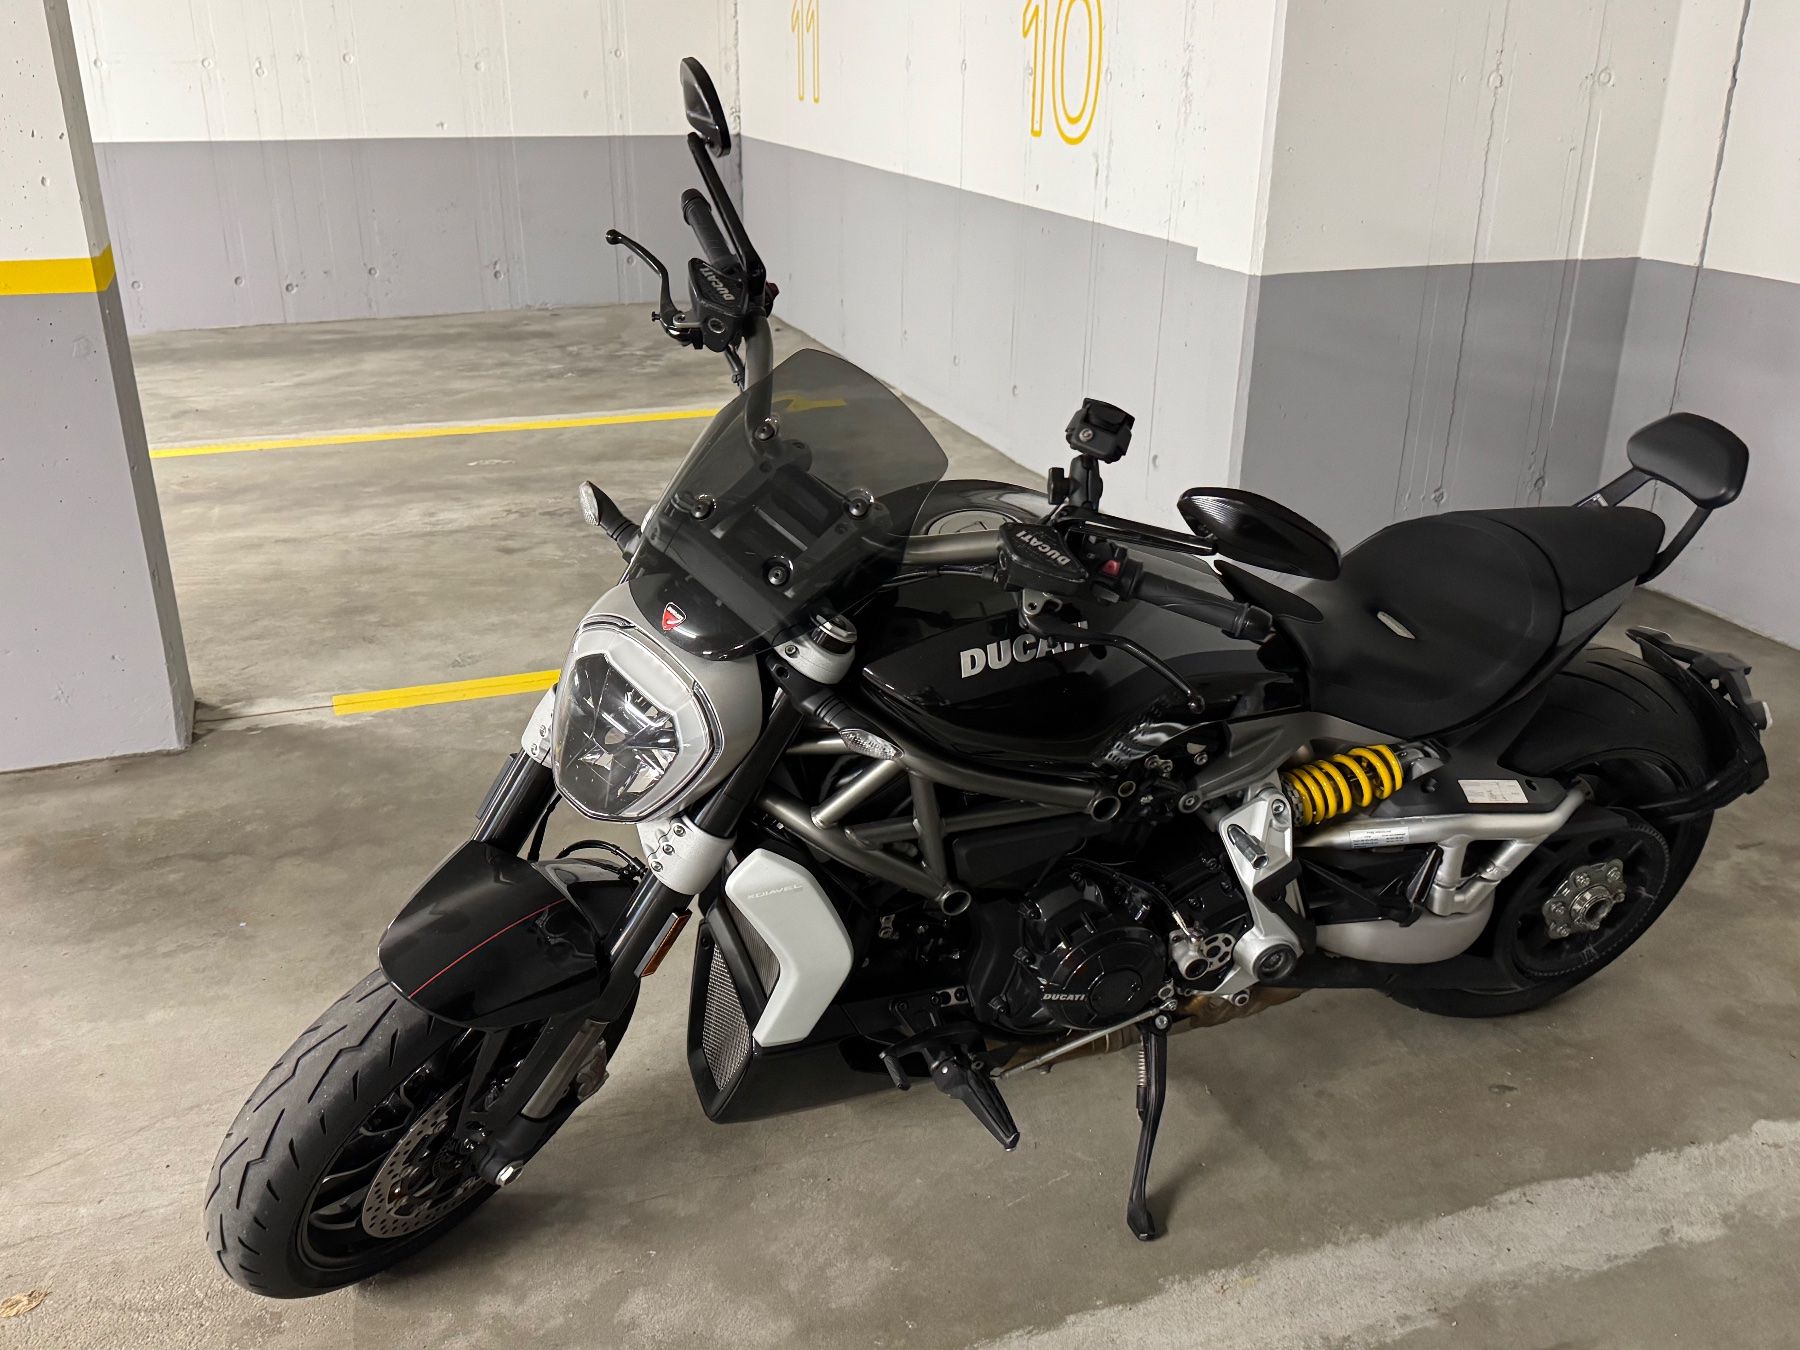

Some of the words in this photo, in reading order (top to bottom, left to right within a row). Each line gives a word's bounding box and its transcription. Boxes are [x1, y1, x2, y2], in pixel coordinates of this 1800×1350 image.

[791, 0, 820, 103] 11
[1022, 0, 1102, 145] 10
[699, 267, 736, 301] DUCATI
[1015, 530, 1071, 566] DUCATI
[1042, 993, 1086, 1001] DUCATI
